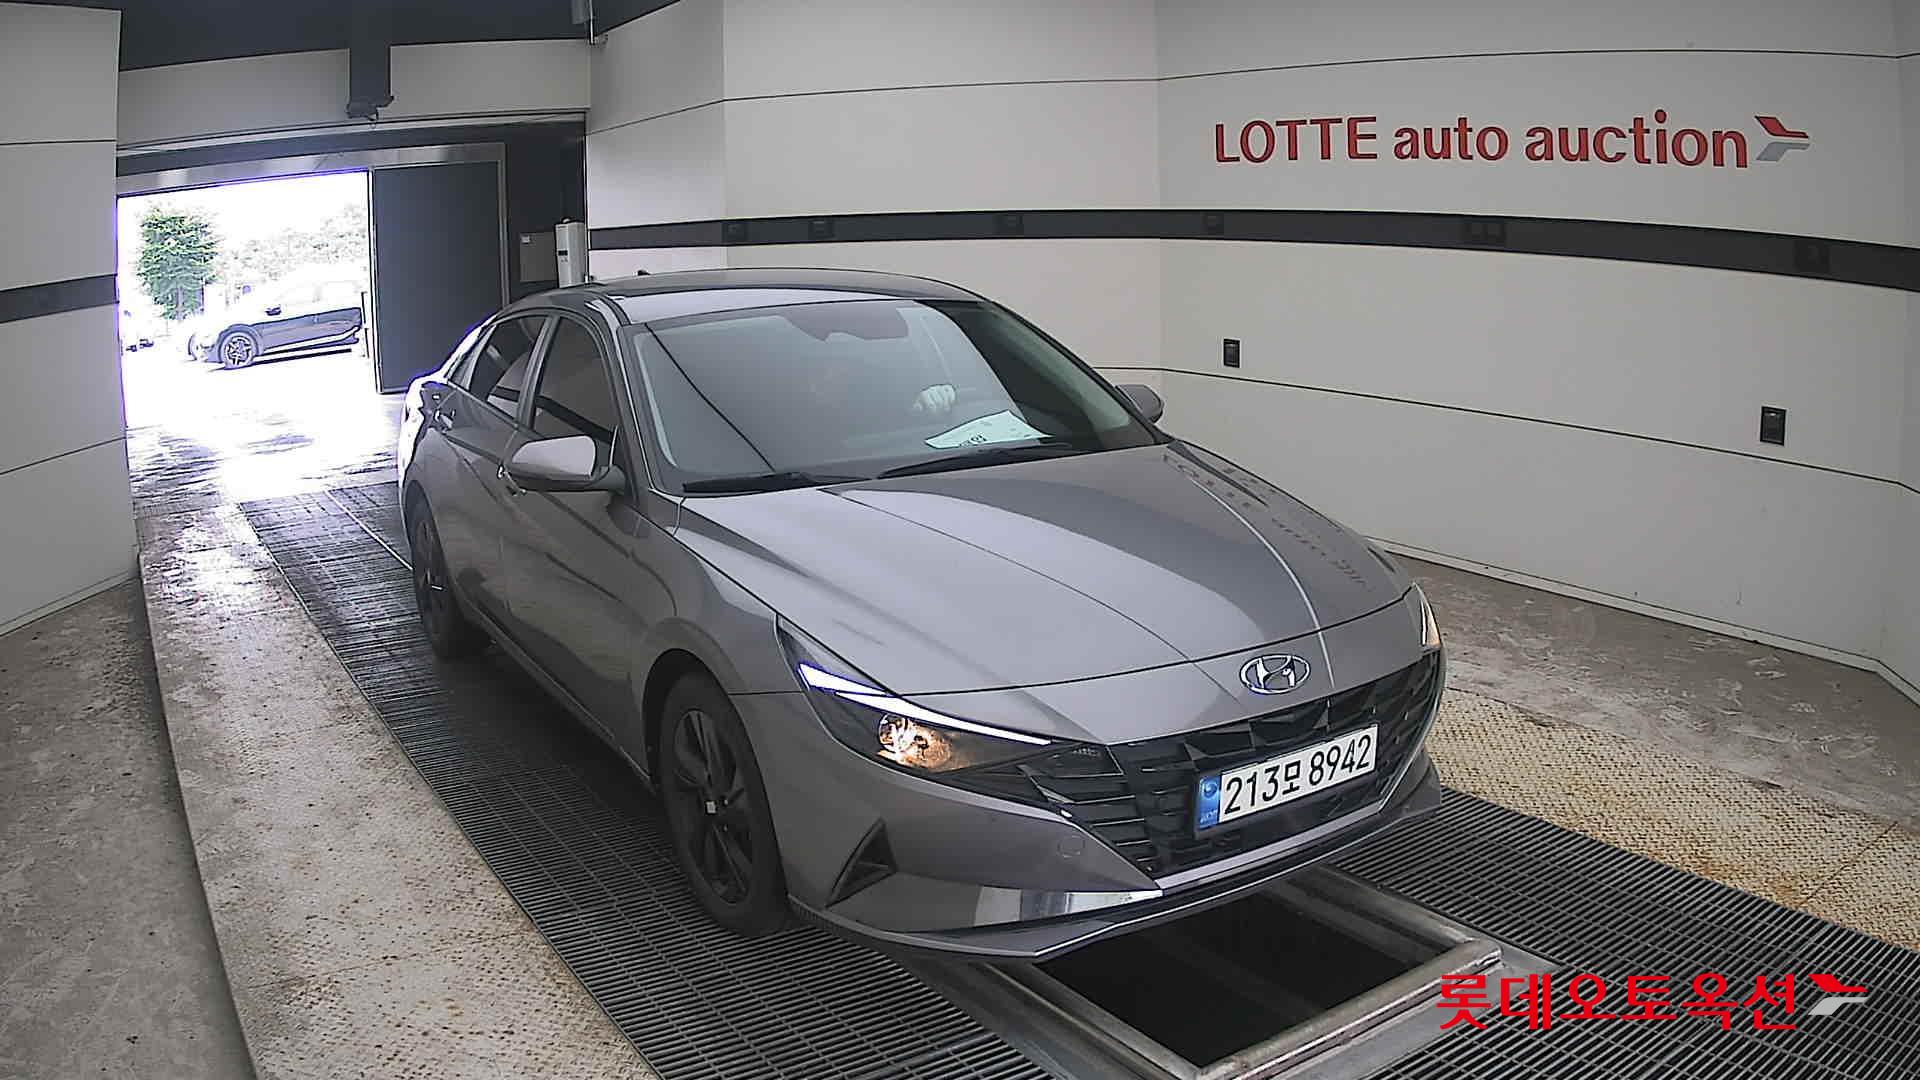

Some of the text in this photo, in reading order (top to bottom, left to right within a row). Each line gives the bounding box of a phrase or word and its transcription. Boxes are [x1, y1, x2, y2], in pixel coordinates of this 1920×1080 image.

[1214, 109, 1749, 169] LOTTE auto auction
[1224, 734, 1372, 815] 213모 8942
